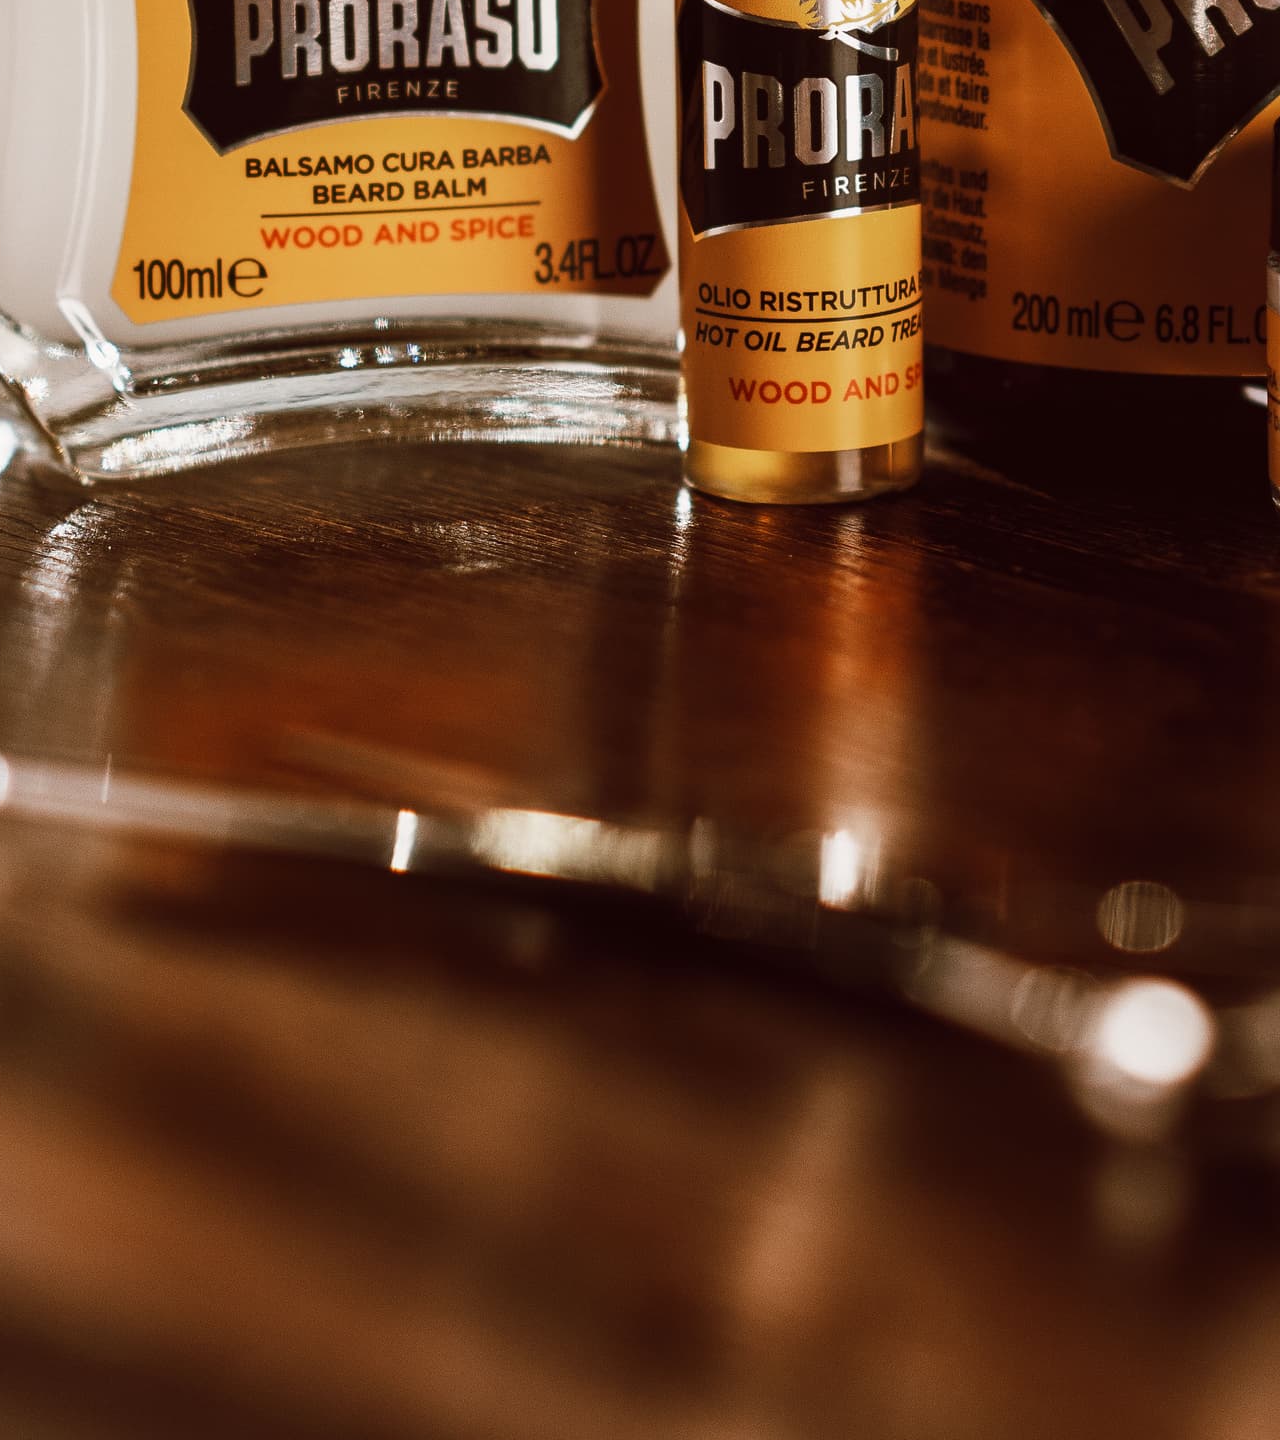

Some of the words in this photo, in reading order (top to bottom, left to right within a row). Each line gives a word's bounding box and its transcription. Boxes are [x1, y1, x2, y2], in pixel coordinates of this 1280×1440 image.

[337, 80, 460, 104] FIRENZE
[955, 76, 989, 104] faire
[702, 60, 917, 169] PRORA
[245, 155, 374, 179] BALSAMO
[382, 151, 455, 174] CURA
[462, 144, 552, 169] BARBA
[312, 181, 404, 205] BEARD
[414, 178, 487, 201] BALM
[802, 168, 910, 200] FIRENZE
[260, 225, 363, 250] WOOD
[374, 220, 440, 245] AND
[450, 215, 535, 241] SPICE
[698, 283, 751, 310] OLIO
[760, 276, 917, 312] RISTRUTTURA
[1012, 291, 1060, 335] 200
[1067, 300, 1100, 338] ml
[1155, 304, 1199, 344] 6.8
[696, 321, 739, 348] HOT
[744, 330, 787, 352] OIL
[796, 325, 884, 352] BEARD
[728, 376, 832, 405] WOOD
[843, 372, 899, 402] AND
